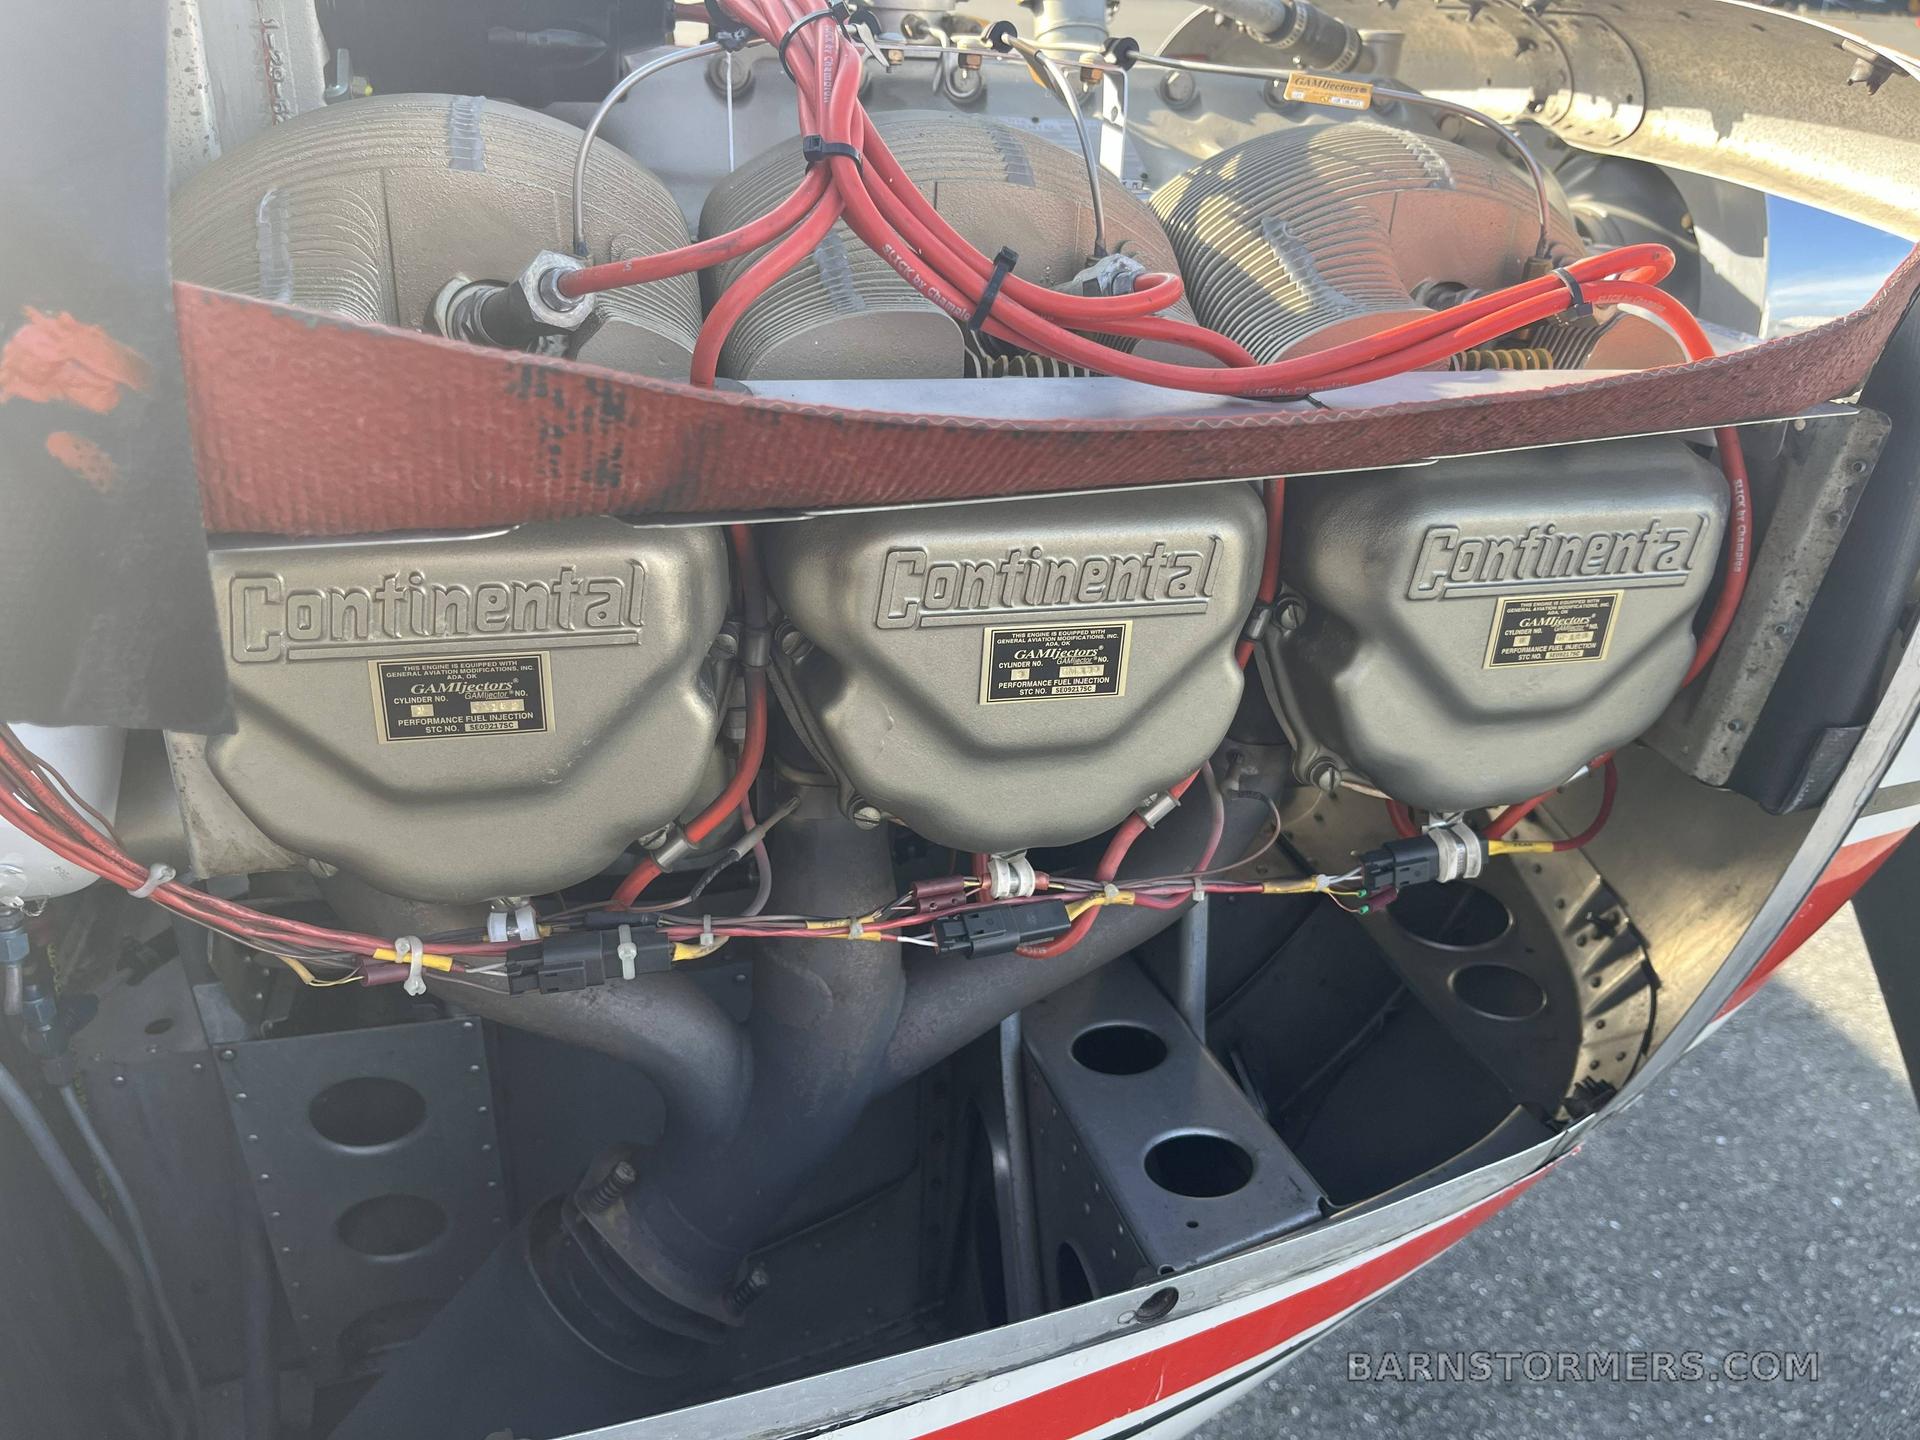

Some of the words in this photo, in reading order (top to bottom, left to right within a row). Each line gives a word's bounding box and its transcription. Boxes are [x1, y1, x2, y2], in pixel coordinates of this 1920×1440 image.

[912, 273, 927, 288] by
[1407, 512, 1710, 600] Continental
[876, 534, 1224, 629] Continental
[228, 558, 647, 663] Continental
[1501, 645, 1548, 654] PERFORMANCE
[998, 661, 1030, 669] CYLINDER
[460, 666, 519, 674] MODIFICATIONS,
[998, 680, 1053, 689] PERFORMANCE
[514, 689, 528, 697] NO.
[393, 696, 433, 704] CYLINDER
[398, 716, 464, 727] PERFORMANCE
[489, 712, 534, 721] INJECTION
[470, 722, 514, 731] SE09217SC
